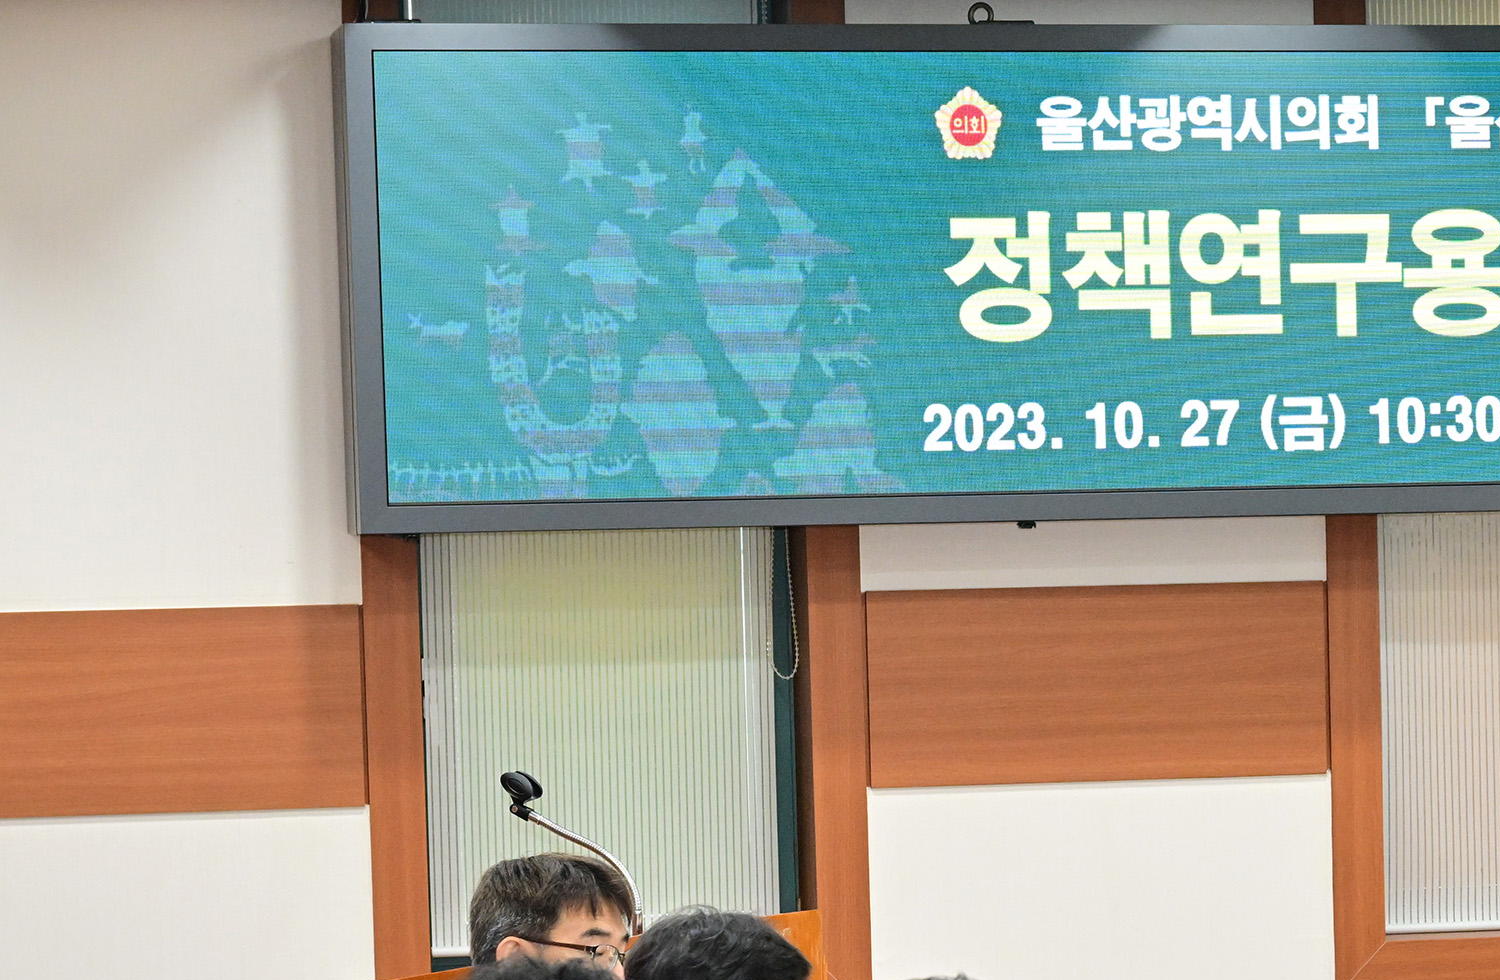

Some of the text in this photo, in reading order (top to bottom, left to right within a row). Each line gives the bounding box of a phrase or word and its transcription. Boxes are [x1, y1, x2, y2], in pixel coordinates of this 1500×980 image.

[952, 115, 986, 135] 의회
[1037, 95, 1379, 151] 울산광역시의회
[923, 401, 1062, 452] 2023.
[1085, 401, 1161, 450] 10.
[1181, 399, 1240, 448] 27
[1260, 394, 1346, 452] (금)
